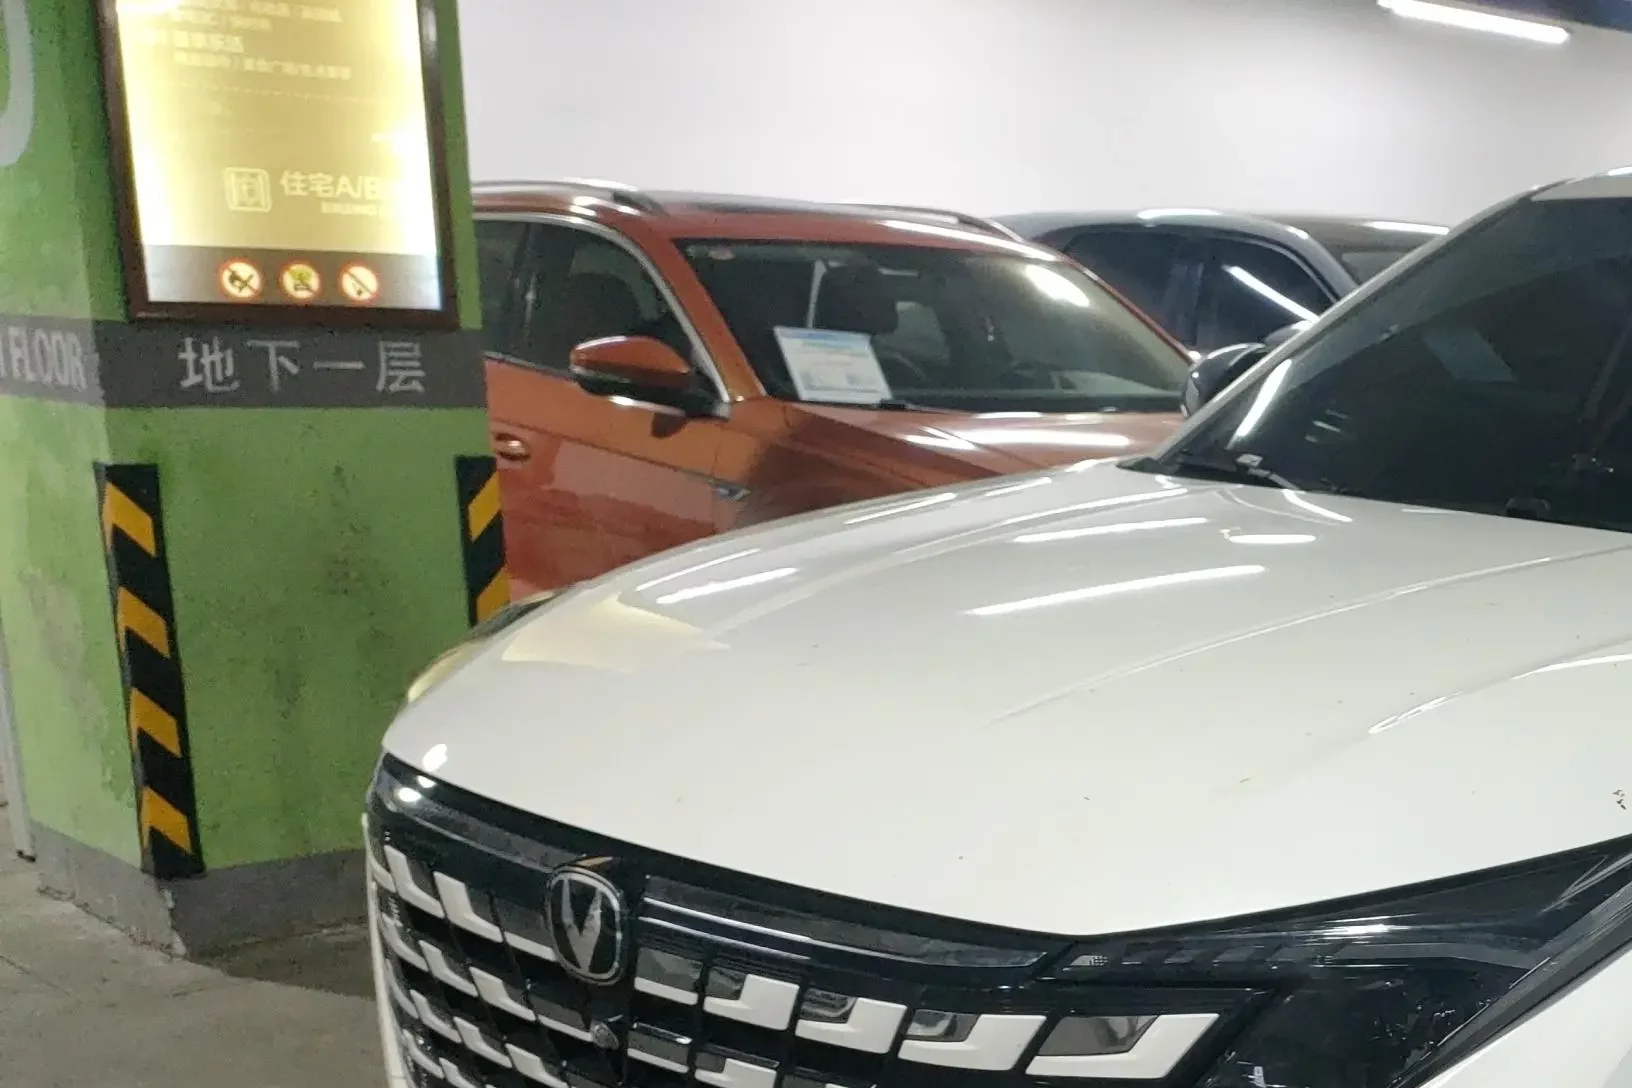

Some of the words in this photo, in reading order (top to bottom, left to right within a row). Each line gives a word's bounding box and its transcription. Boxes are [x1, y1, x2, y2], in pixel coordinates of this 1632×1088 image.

[8, 326, 88, 393] FLOOR
[179, 336, 427, 393] 地下一层
